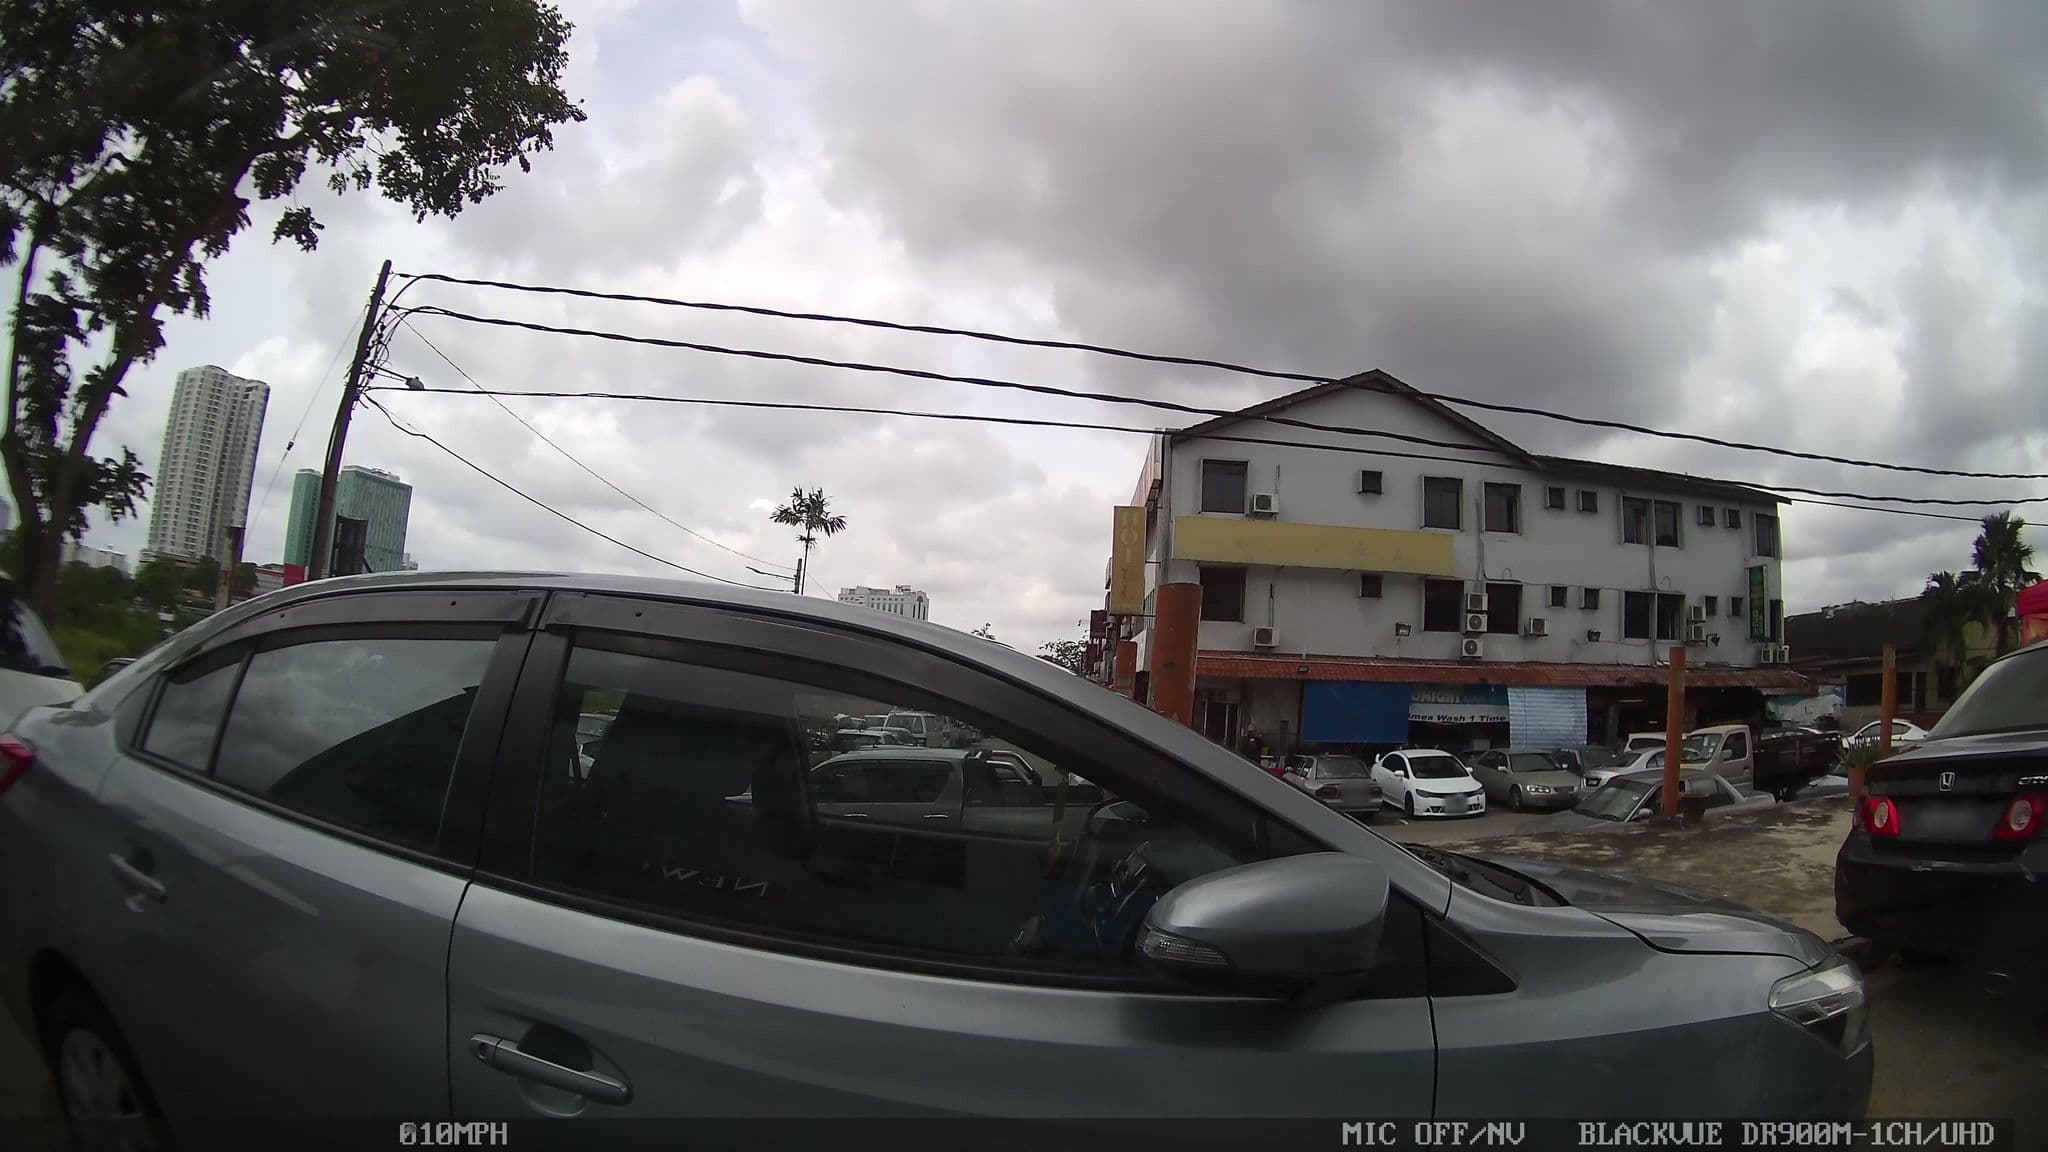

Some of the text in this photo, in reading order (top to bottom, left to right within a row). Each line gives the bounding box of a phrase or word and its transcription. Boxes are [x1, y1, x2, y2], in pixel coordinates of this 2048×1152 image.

[1437, 713, 1465, 722] Wash
[1469, 714, 1476, 722] 1
[1478, 714, 1506, 722] Time
